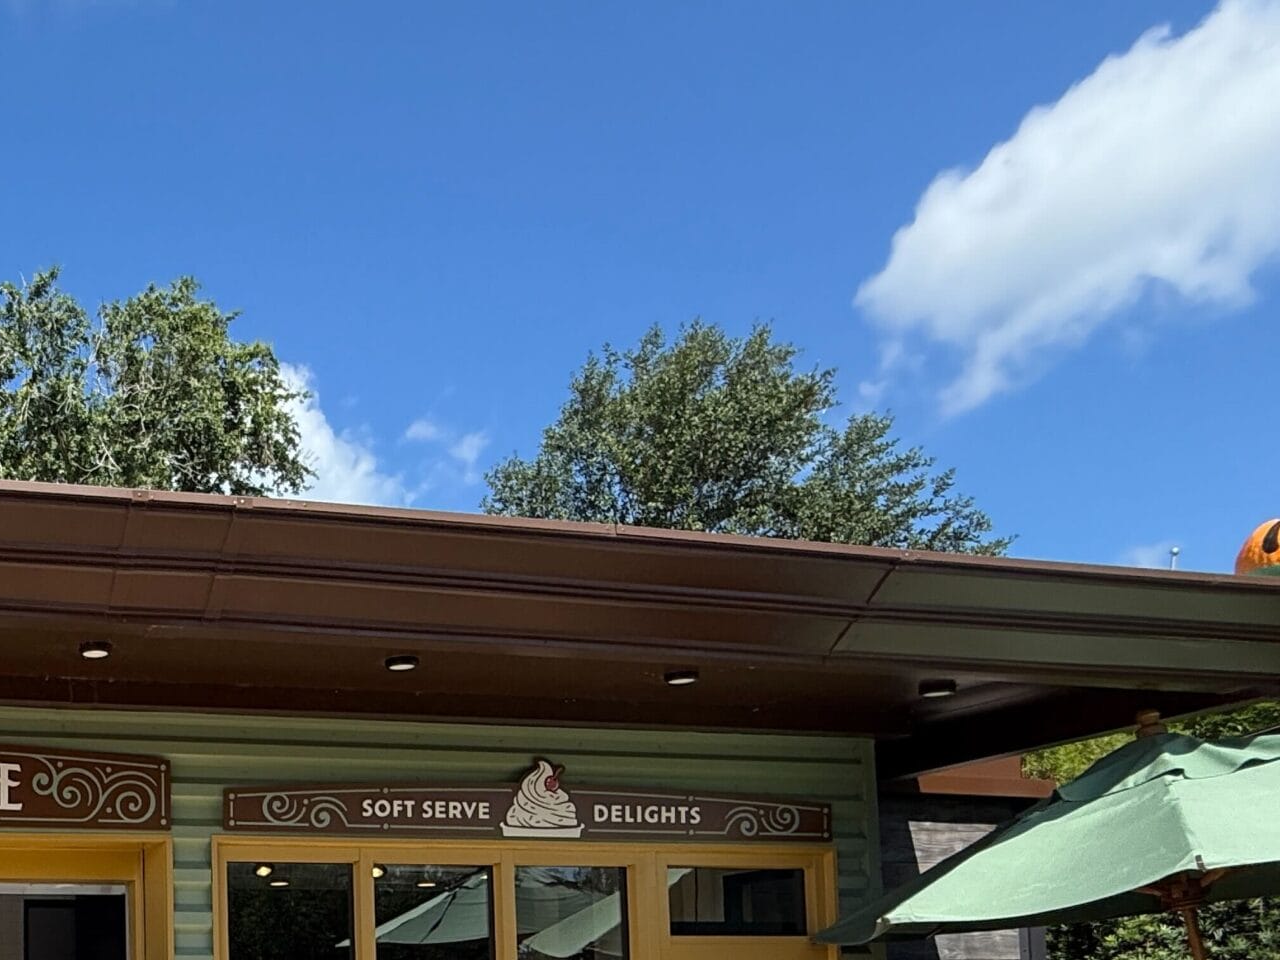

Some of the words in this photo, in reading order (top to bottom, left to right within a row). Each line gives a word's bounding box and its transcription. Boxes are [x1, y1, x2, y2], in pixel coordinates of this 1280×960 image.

[362, 799, 416, 819] SOFT
[422, 800, 490, 820] SERVE
[593, 804, 702, 825] DELIGHTS
